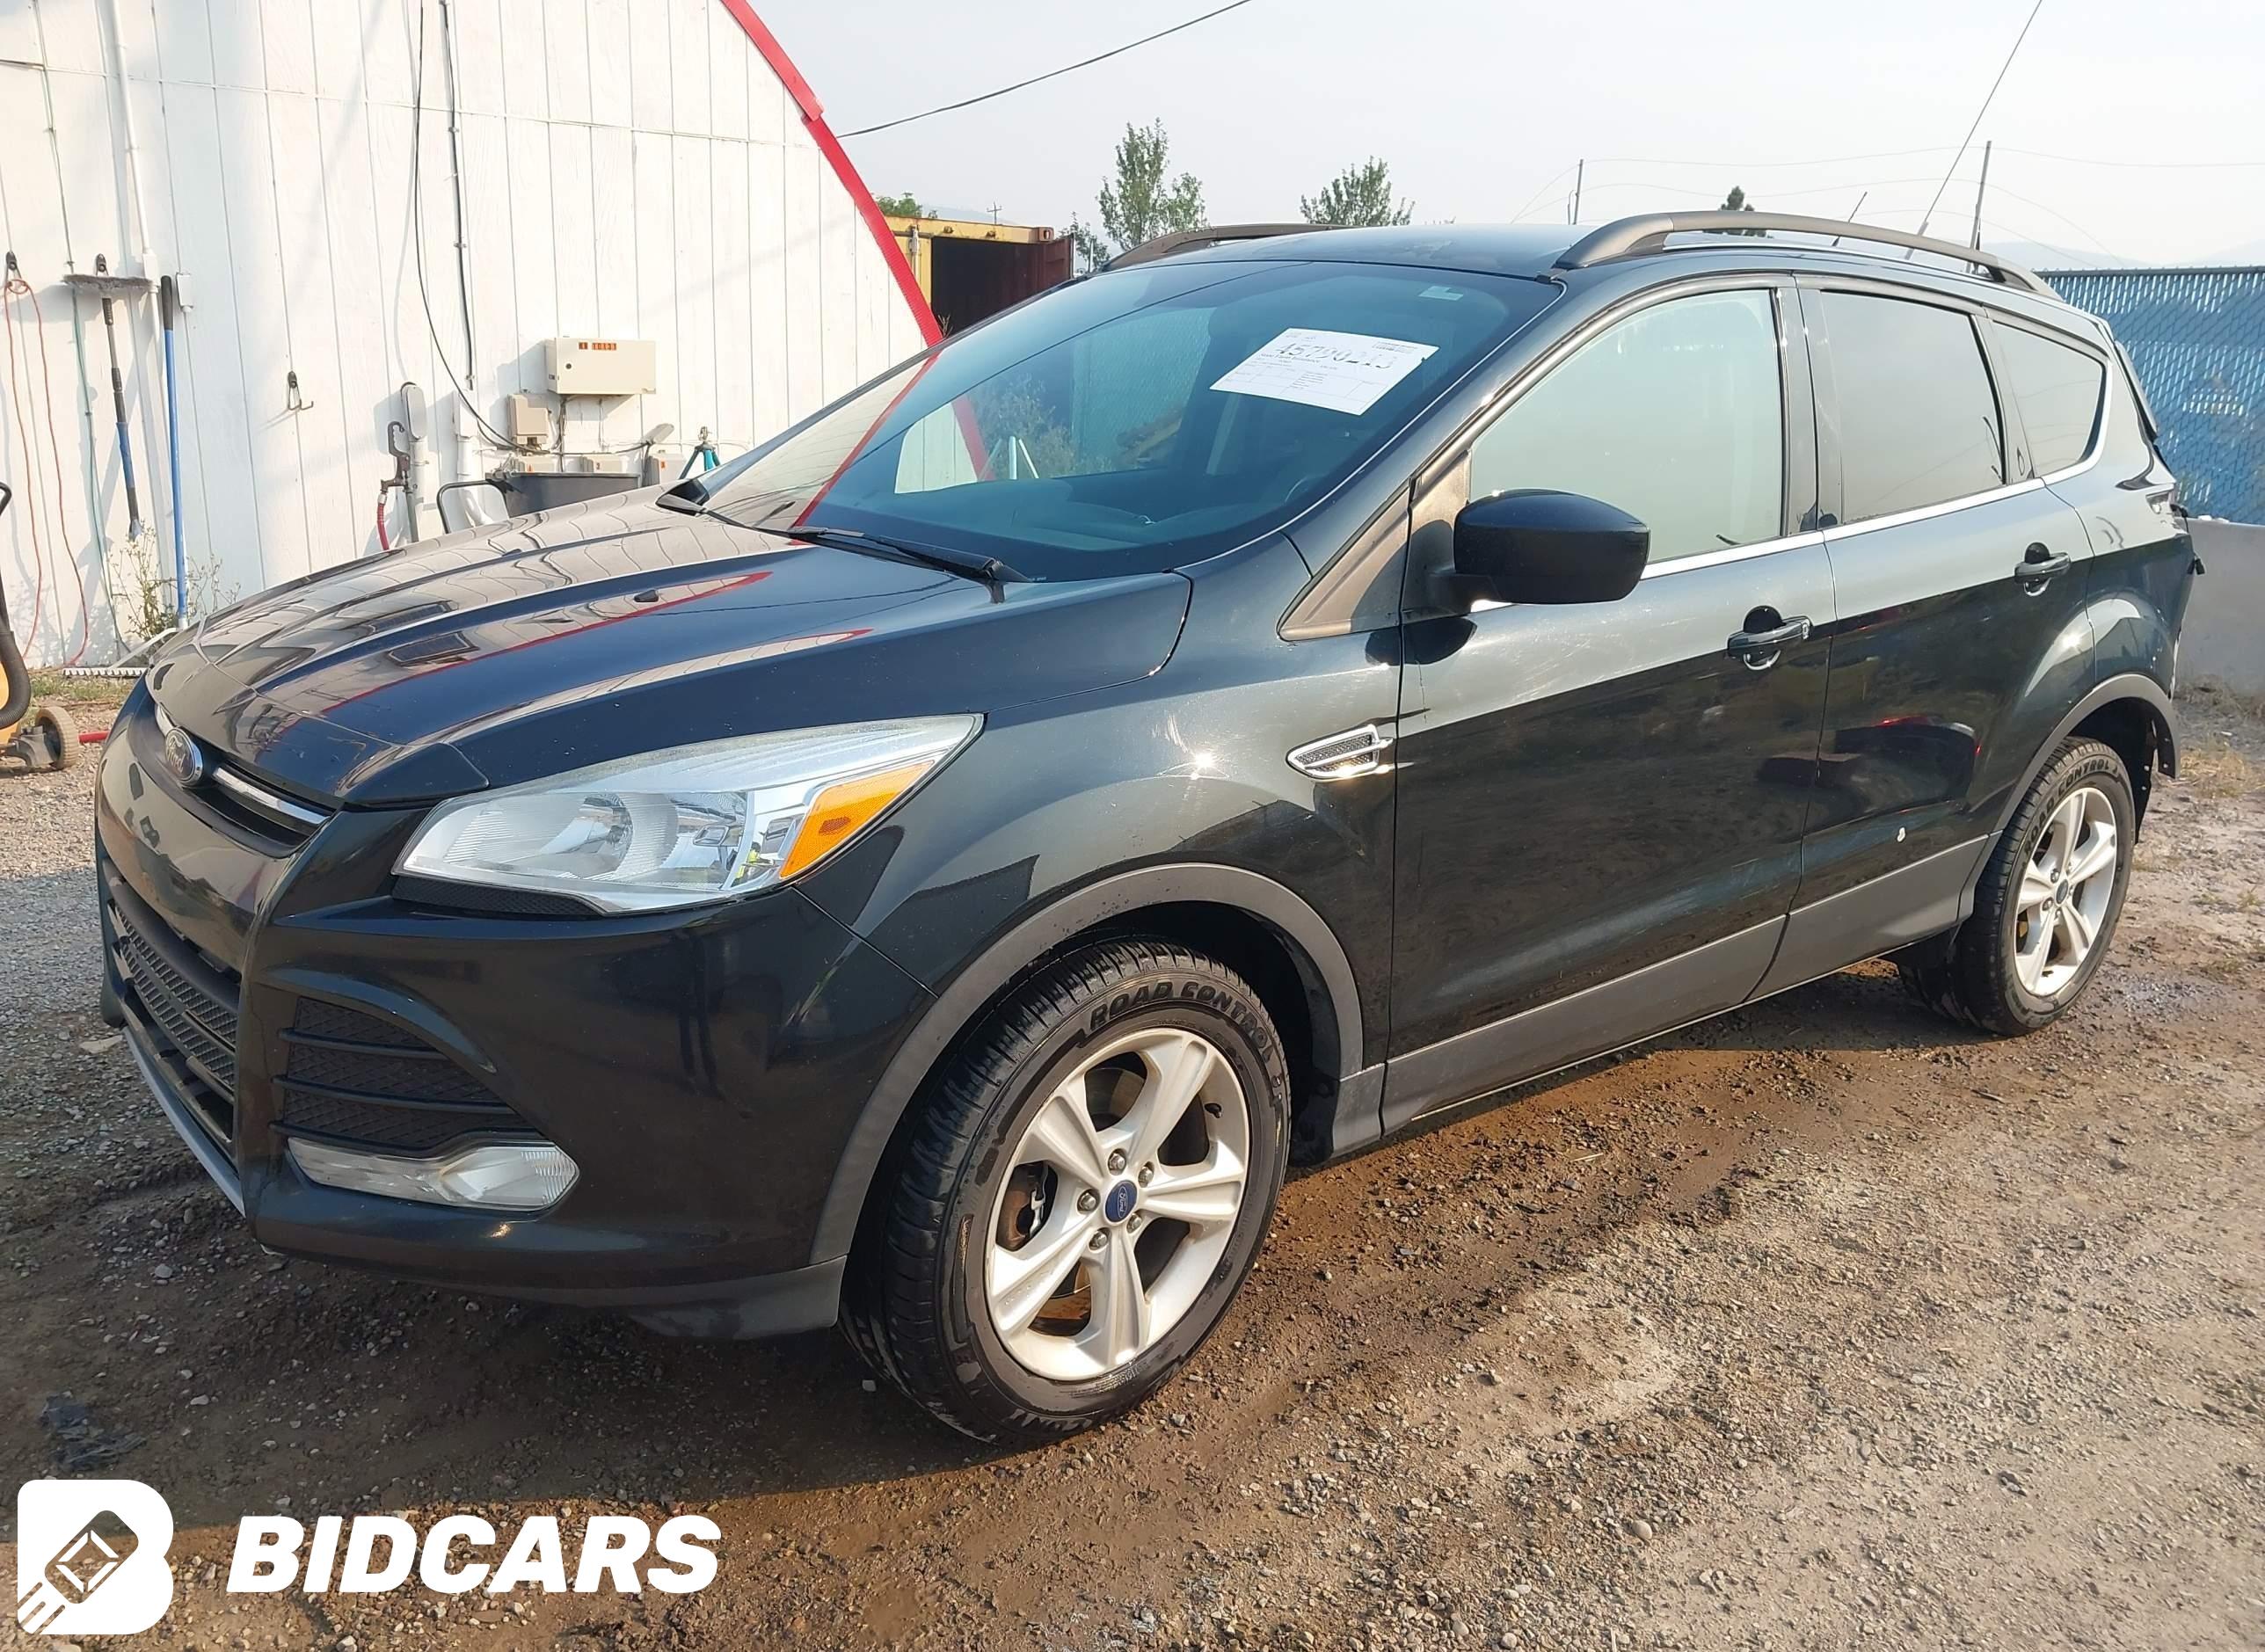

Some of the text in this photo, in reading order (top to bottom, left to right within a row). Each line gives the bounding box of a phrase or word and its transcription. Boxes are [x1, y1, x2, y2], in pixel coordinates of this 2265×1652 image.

[165, 734, 186, 775] Ford
[1089, 980, 1275, 1064] ROAD CONTROL
